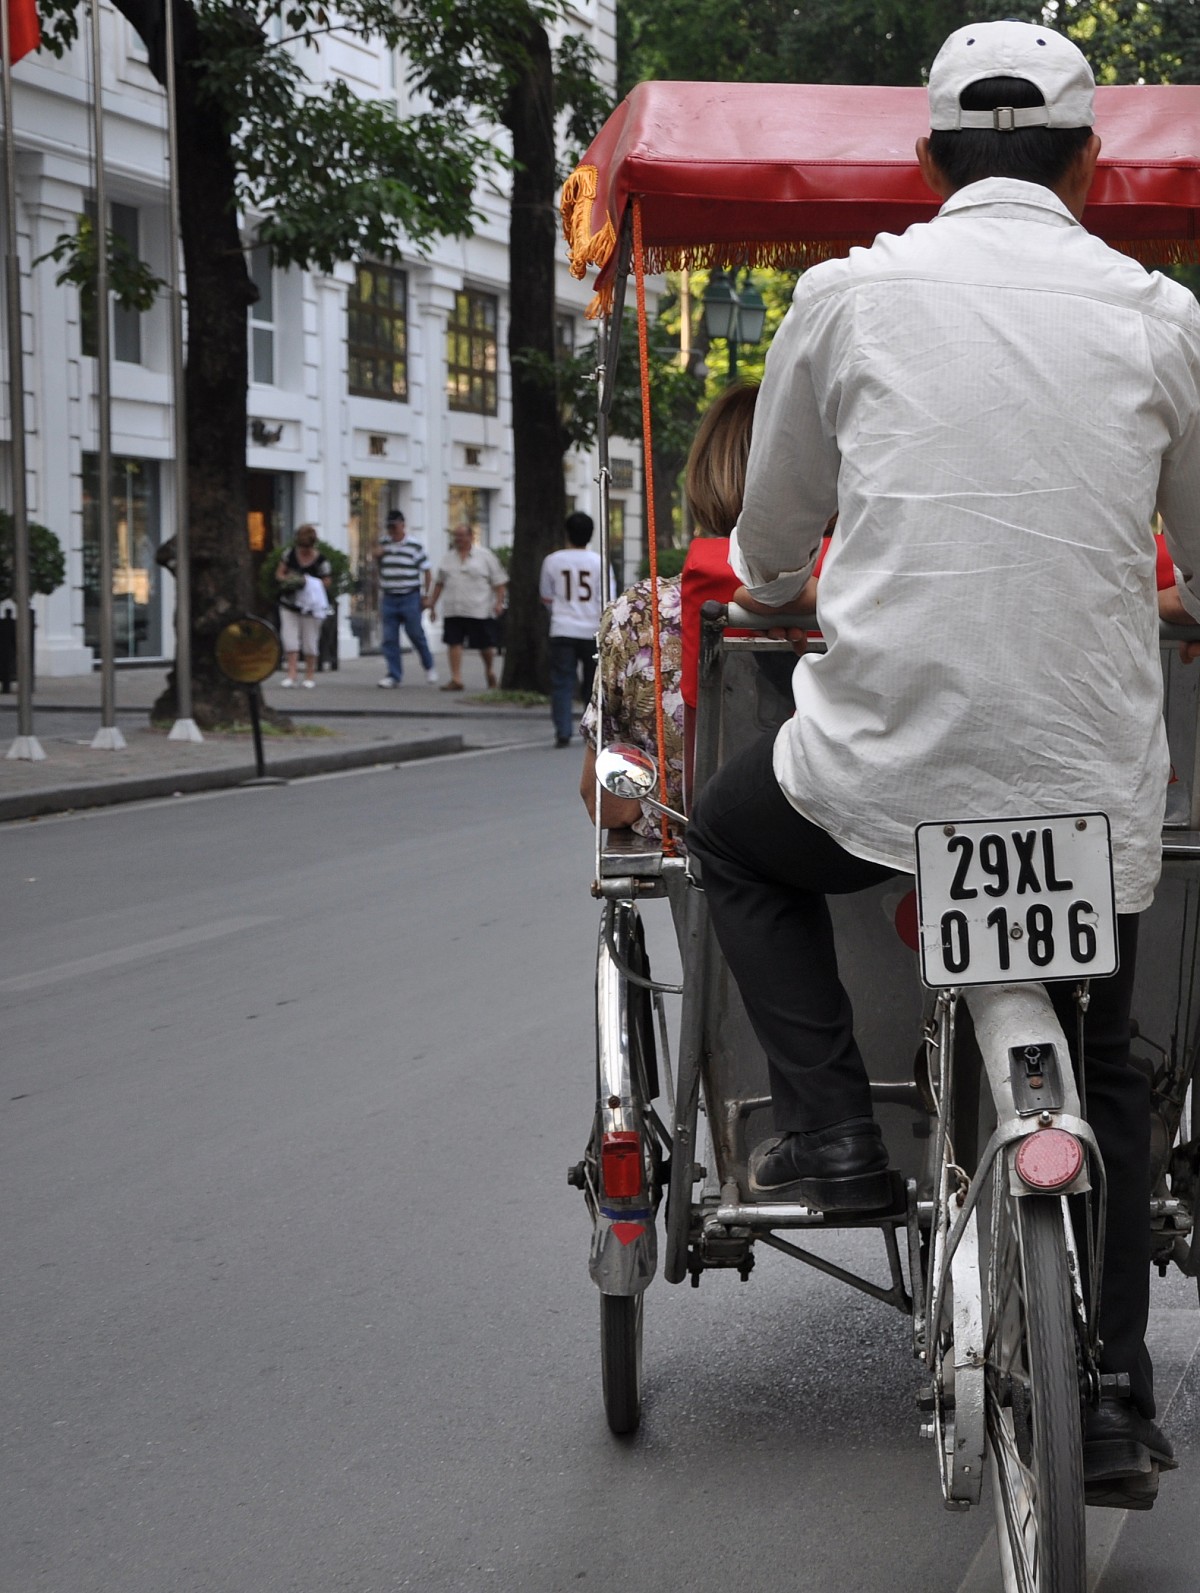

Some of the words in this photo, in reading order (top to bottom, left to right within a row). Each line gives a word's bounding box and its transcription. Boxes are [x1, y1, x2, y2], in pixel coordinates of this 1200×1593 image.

[561, 570, 592, 601] 15
[947, 828, 1073, 900] 29XL
[941, 900, 1097, 973] 0186
